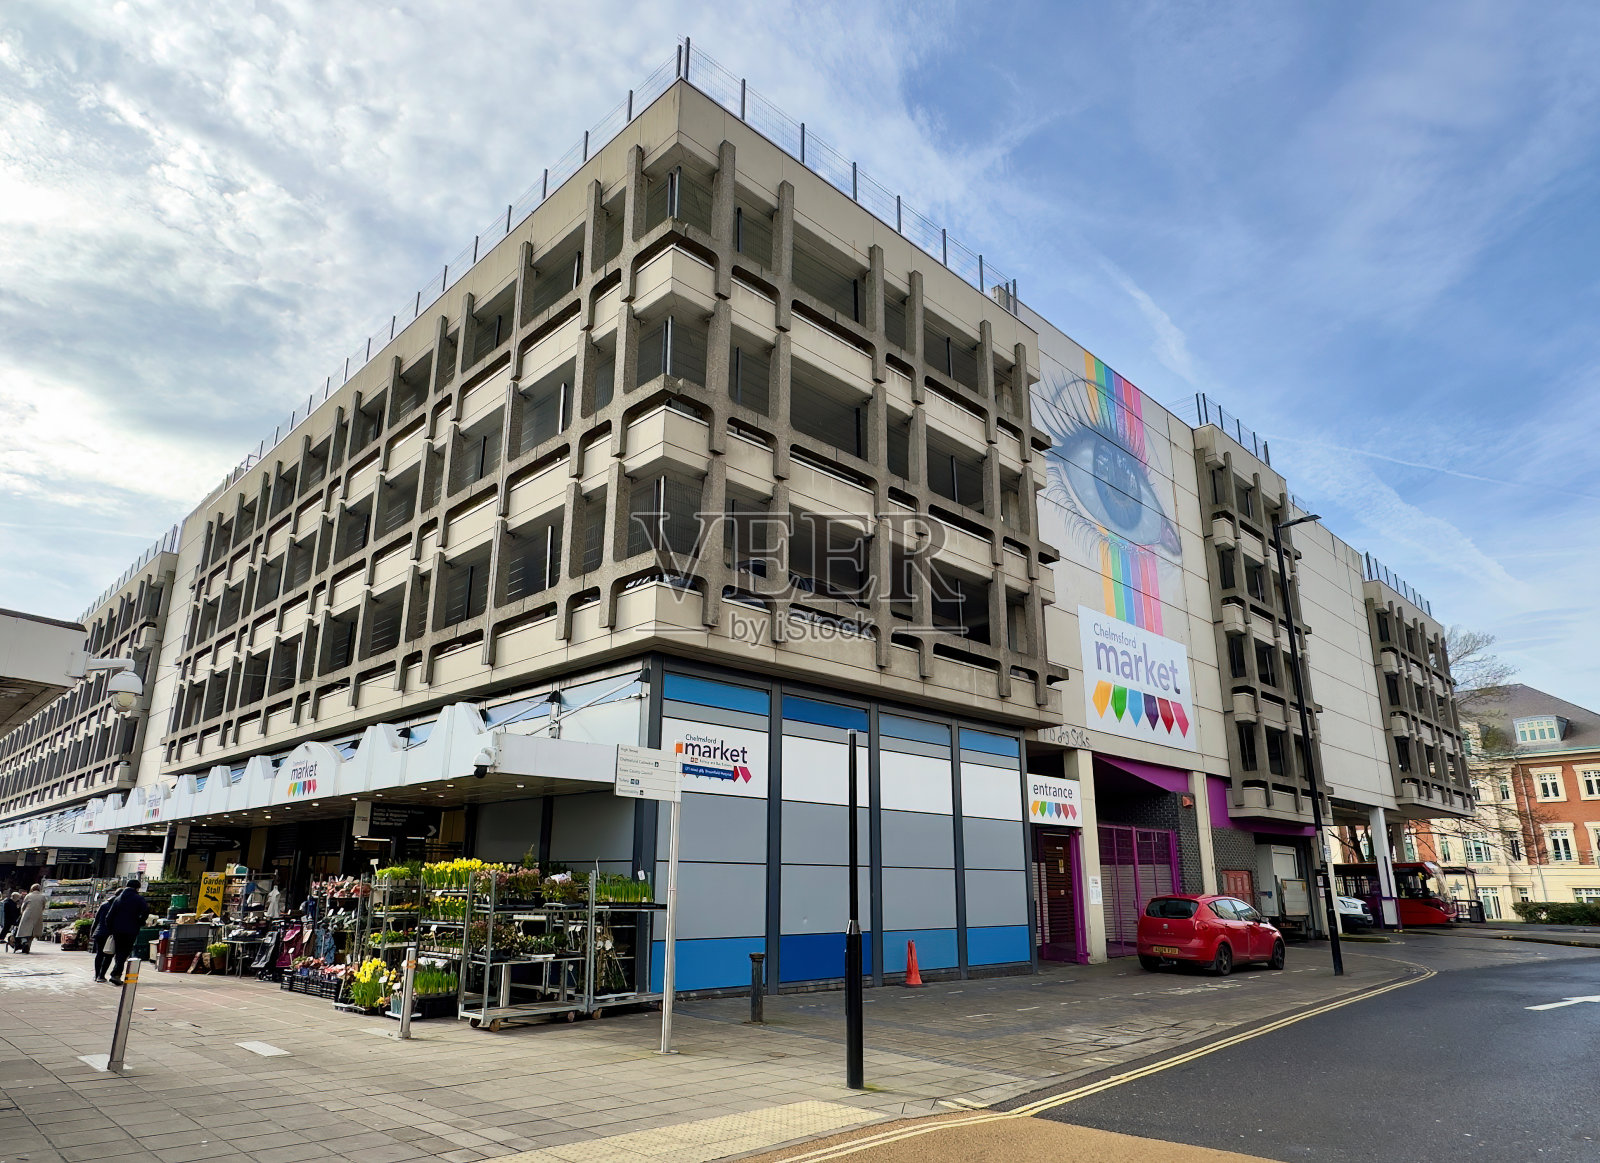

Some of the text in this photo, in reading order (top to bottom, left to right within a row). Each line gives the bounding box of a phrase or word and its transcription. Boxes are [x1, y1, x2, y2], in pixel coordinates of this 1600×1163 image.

[1093, 622, 1137, 649] Chelmsford
[1094, 641, 1181, 695] market
[685, 733, 717, 745] Chelmsford
[684, 739, 748, 764] market
[290, 760, 318, 780] market
[1032, 783, 1073, 799] entrance
[206, 886, 221, 894] Stall
